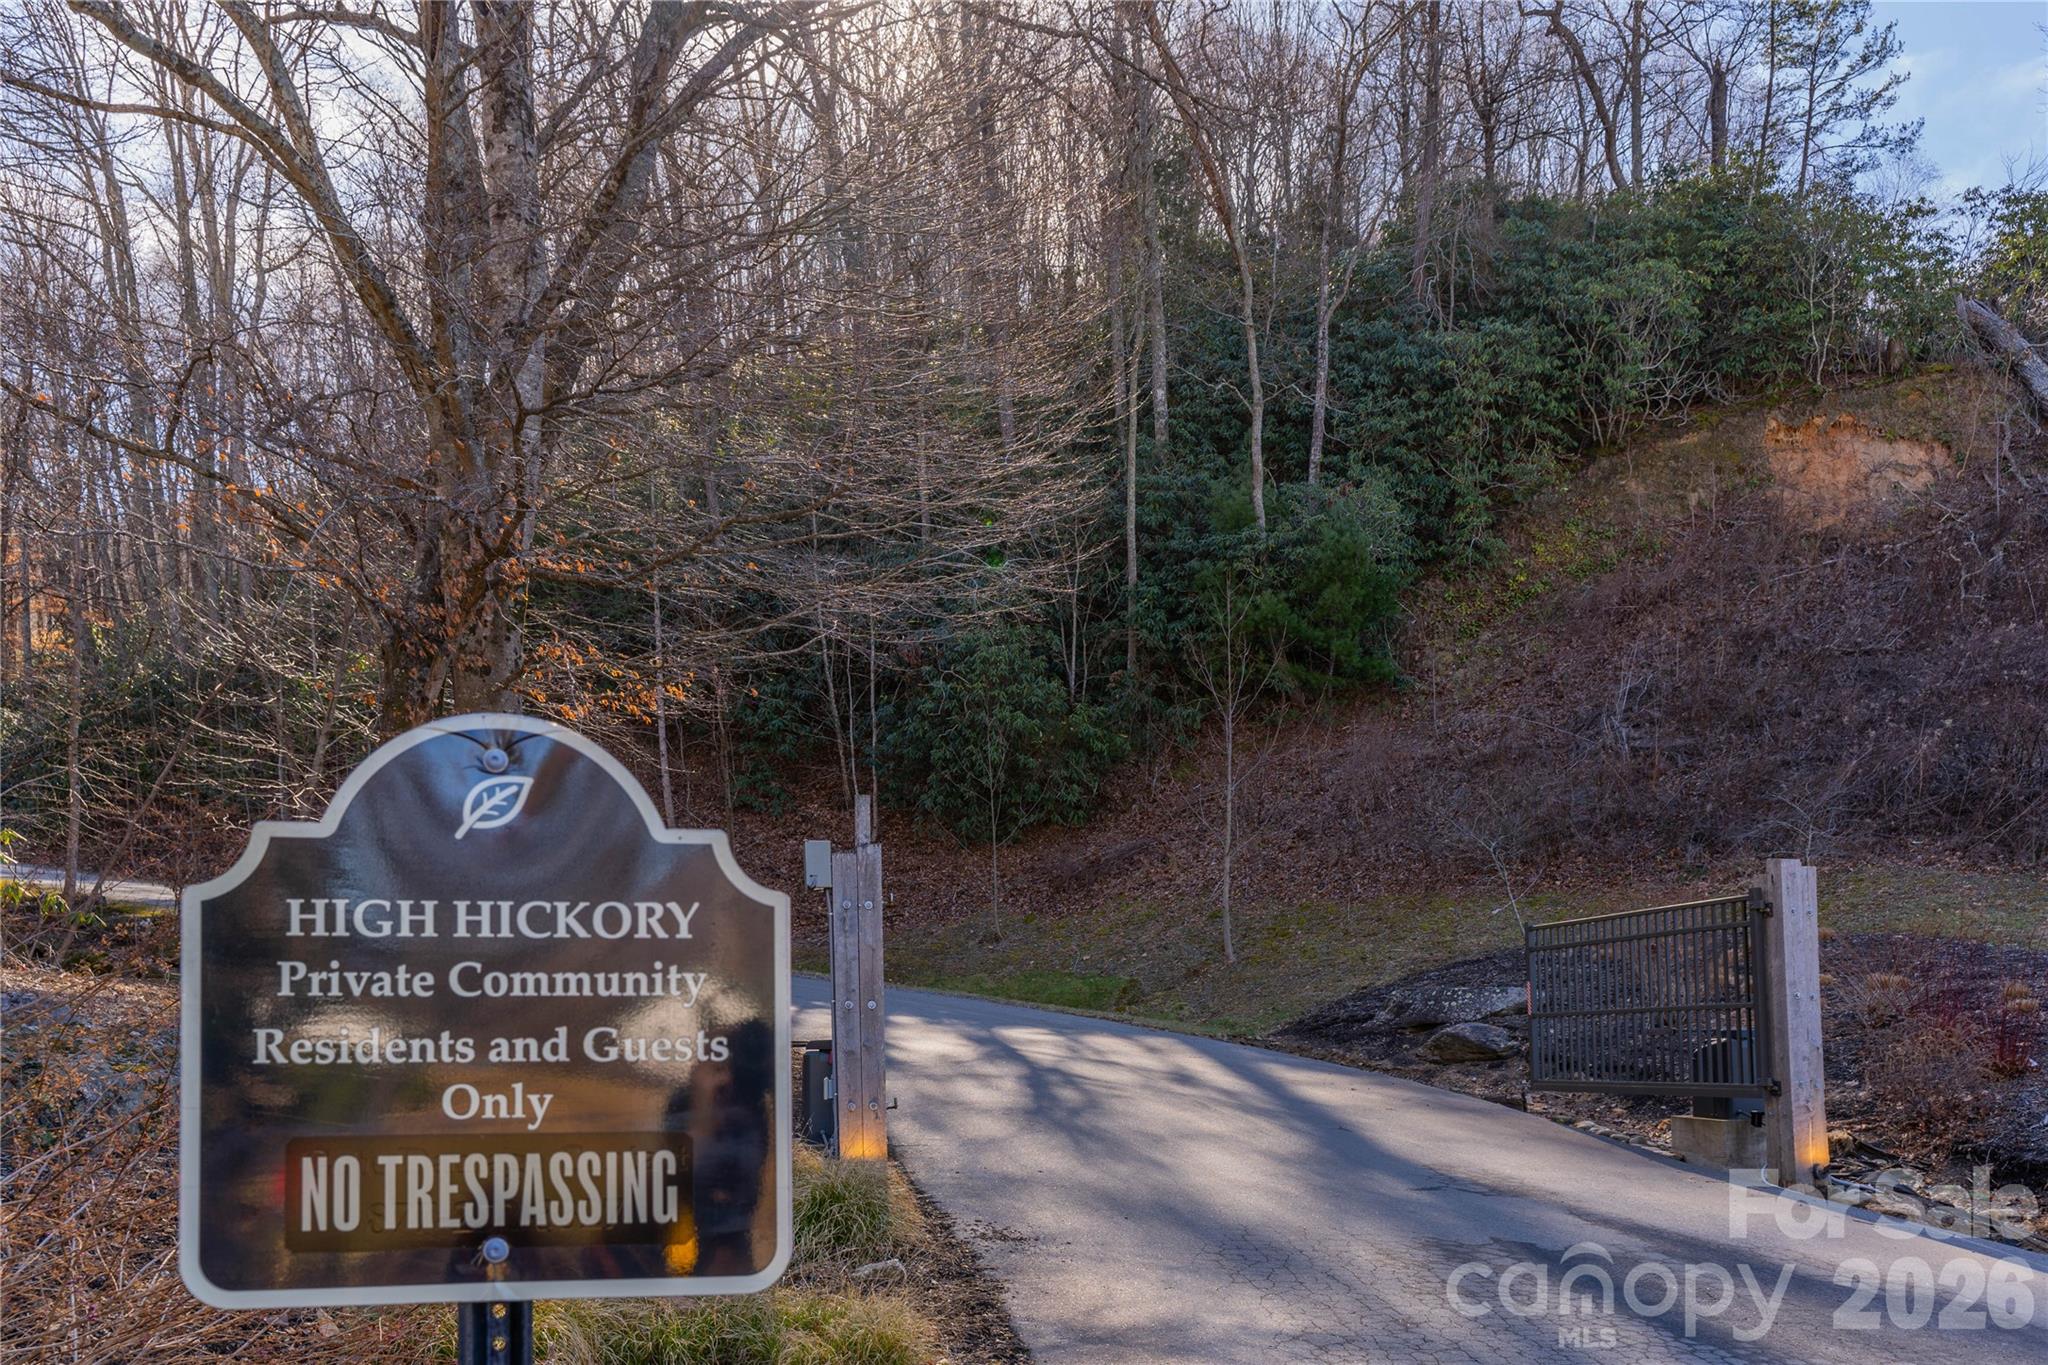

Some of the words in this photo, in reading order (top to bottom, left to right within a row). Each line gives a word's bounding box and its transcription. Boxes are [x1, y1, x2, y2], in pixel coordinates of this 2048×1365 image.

[285, 898, 439, 938] HIGH
[452, 900, 700, 939] HICKORY
[276, 960, 435, 998] Private
[448, 960, 707, 1007] Community
[252, 1027, 476, 1066] Residents
[489, 1026, 570, 1064] and
[583, 1026, 730, 1064] Guests
[441, 1083, 554, 1130] Only
[301, 1155, 361, 1232] NO
[377, 1149, 679, 1230] TRESPASSING
